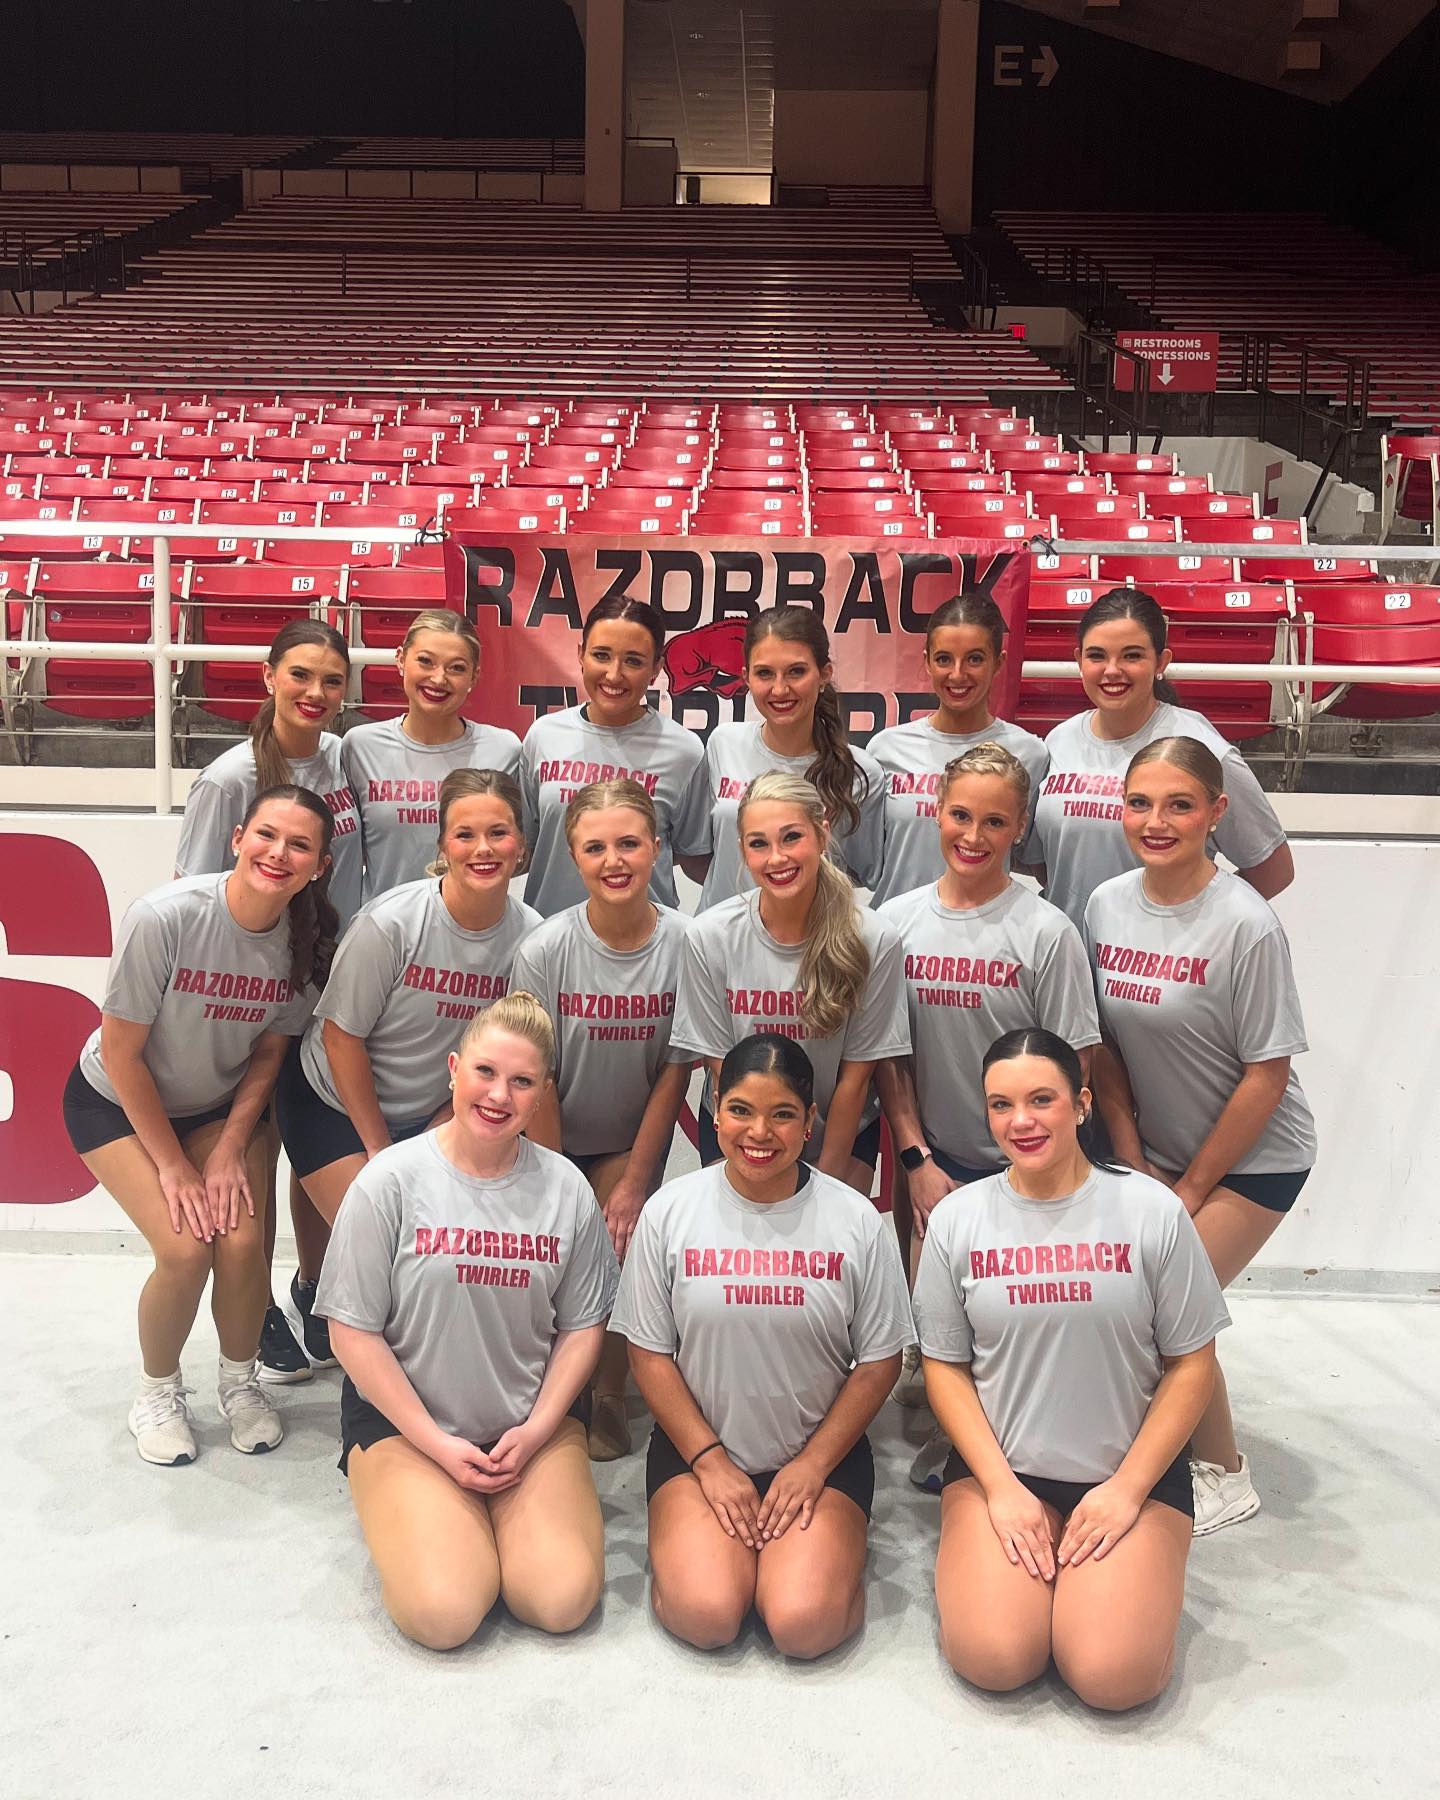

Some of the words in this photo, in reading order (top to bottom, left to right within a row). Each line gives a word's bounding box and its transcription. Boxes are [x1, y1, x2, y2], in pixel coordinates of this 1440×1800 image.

[993, 46, 1024, 87] E
[1134, 339, 1201, 348] RESTROOMS
[989, 502, 1000, 511] 20
[163, 511, 172, 520] 13
[283, 513, 291, 522] 14
[403, 516, 413, 525] 15
[524, 519, 534, 527] 16
[888, 525, 898, 534] 19
[88, 537, 98, 548] 13
[223, 540, 233, 550] 14
[356, 543, 367, 554] 15
[1183, 557, 1196, 568] 21
[1318, 558, 1332, 570] 22
[143, 575, 154, 586] 14
[298, 578, 310, 590] 15
[463, 545, 1014, 633] RAZORBACK
[1072, 591, 1088, 603] 20
[1231, 594, 1245, 606] 21
[1389, 595, 1405, 607] 22
[397, 808, 438, 823] TWIR
[1063, 801, 1123, 821] TWIRLER
[904, 954, 1023, 987] AZORBACK
[403, 963, 511, 1000] RAZORBA
[916, 987, 982, 1009] TWIRLER
[1104, 978, 1162, 1005] TWIRLER
[558, 991, 675, 1019] RAZORBAC
[203, 1003, 267, 1022] TWIRLER
[588, 1025, 656, 1040] TWIRLER
[415, 1227, 561, 1265] RAZORBACK
[685, 1248, 844, 1281] RAZORBACK
[970, 1242, 1132, 1280] RAZORBACK
[456, 1263, 531, 1288] TWIRLER
[723, 1284, 805, 1306] TWIRLER
[1006, 1281, 1092, 1305] TWIRLER
